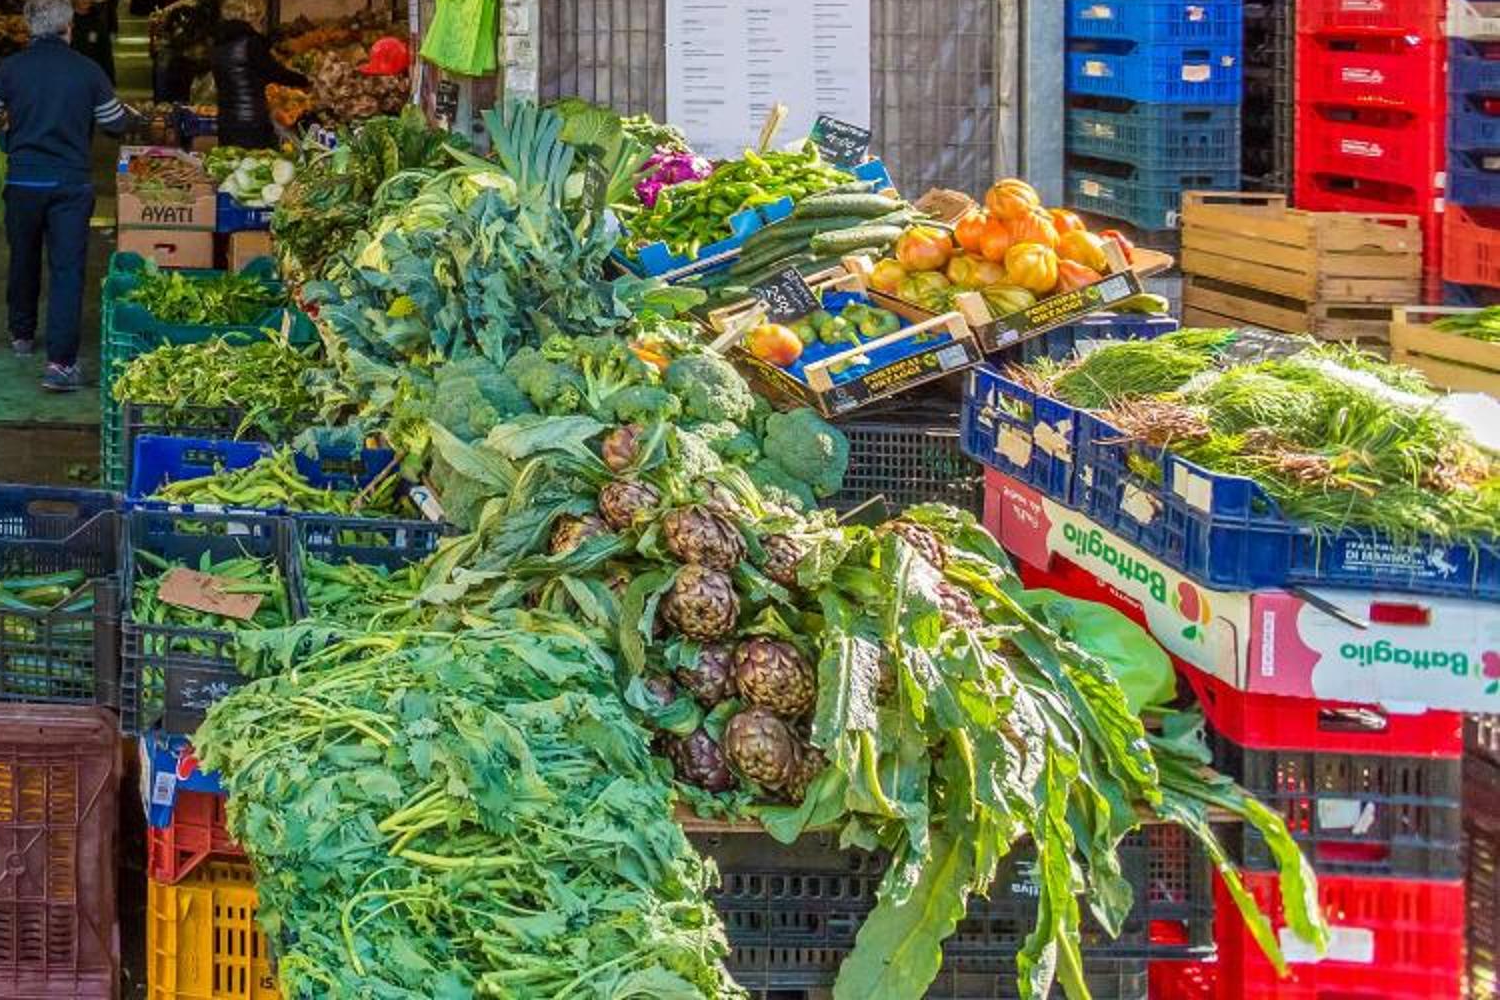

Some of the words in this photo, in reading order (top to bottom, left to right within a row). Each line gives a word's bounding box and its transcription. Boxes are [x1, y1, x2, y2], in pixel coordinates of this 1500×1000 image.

[141, 205, 194, 223] AYATI
[1062, 522, 1167, 603] Battaglio
[1339, 640, 1469, 677] Battaglio
